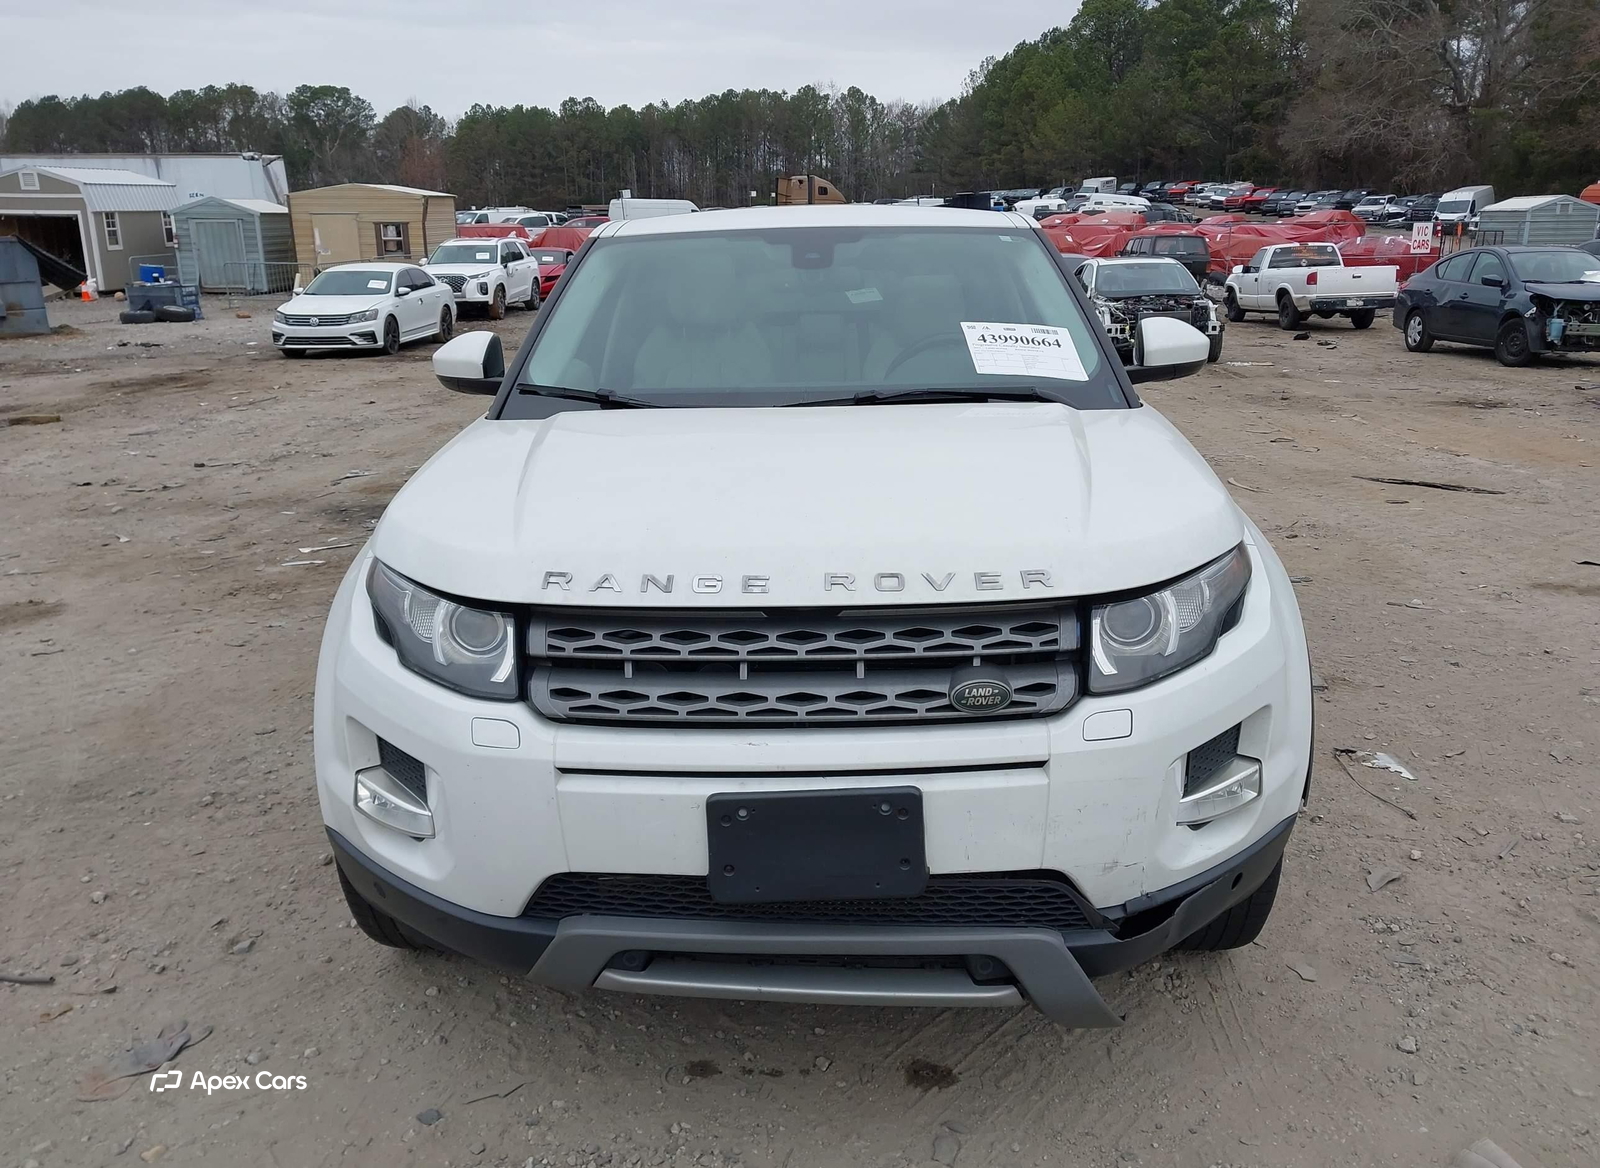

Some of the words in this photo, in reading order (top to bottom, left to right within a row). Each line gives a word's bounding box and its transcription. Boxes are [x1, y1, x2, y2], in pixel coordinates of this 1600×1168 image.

[1417, 225, 1429, 237] VIC
[1412, 239, 1430, 250] CARS
[977, 333, 1062, 348] 43990664
[541, 570, 770, 594] RANGE
[824, 569, 1054, 592] ROVER
[964, 688, 993, 697] LAND
[966, 696, 1002, 706] ROVER
